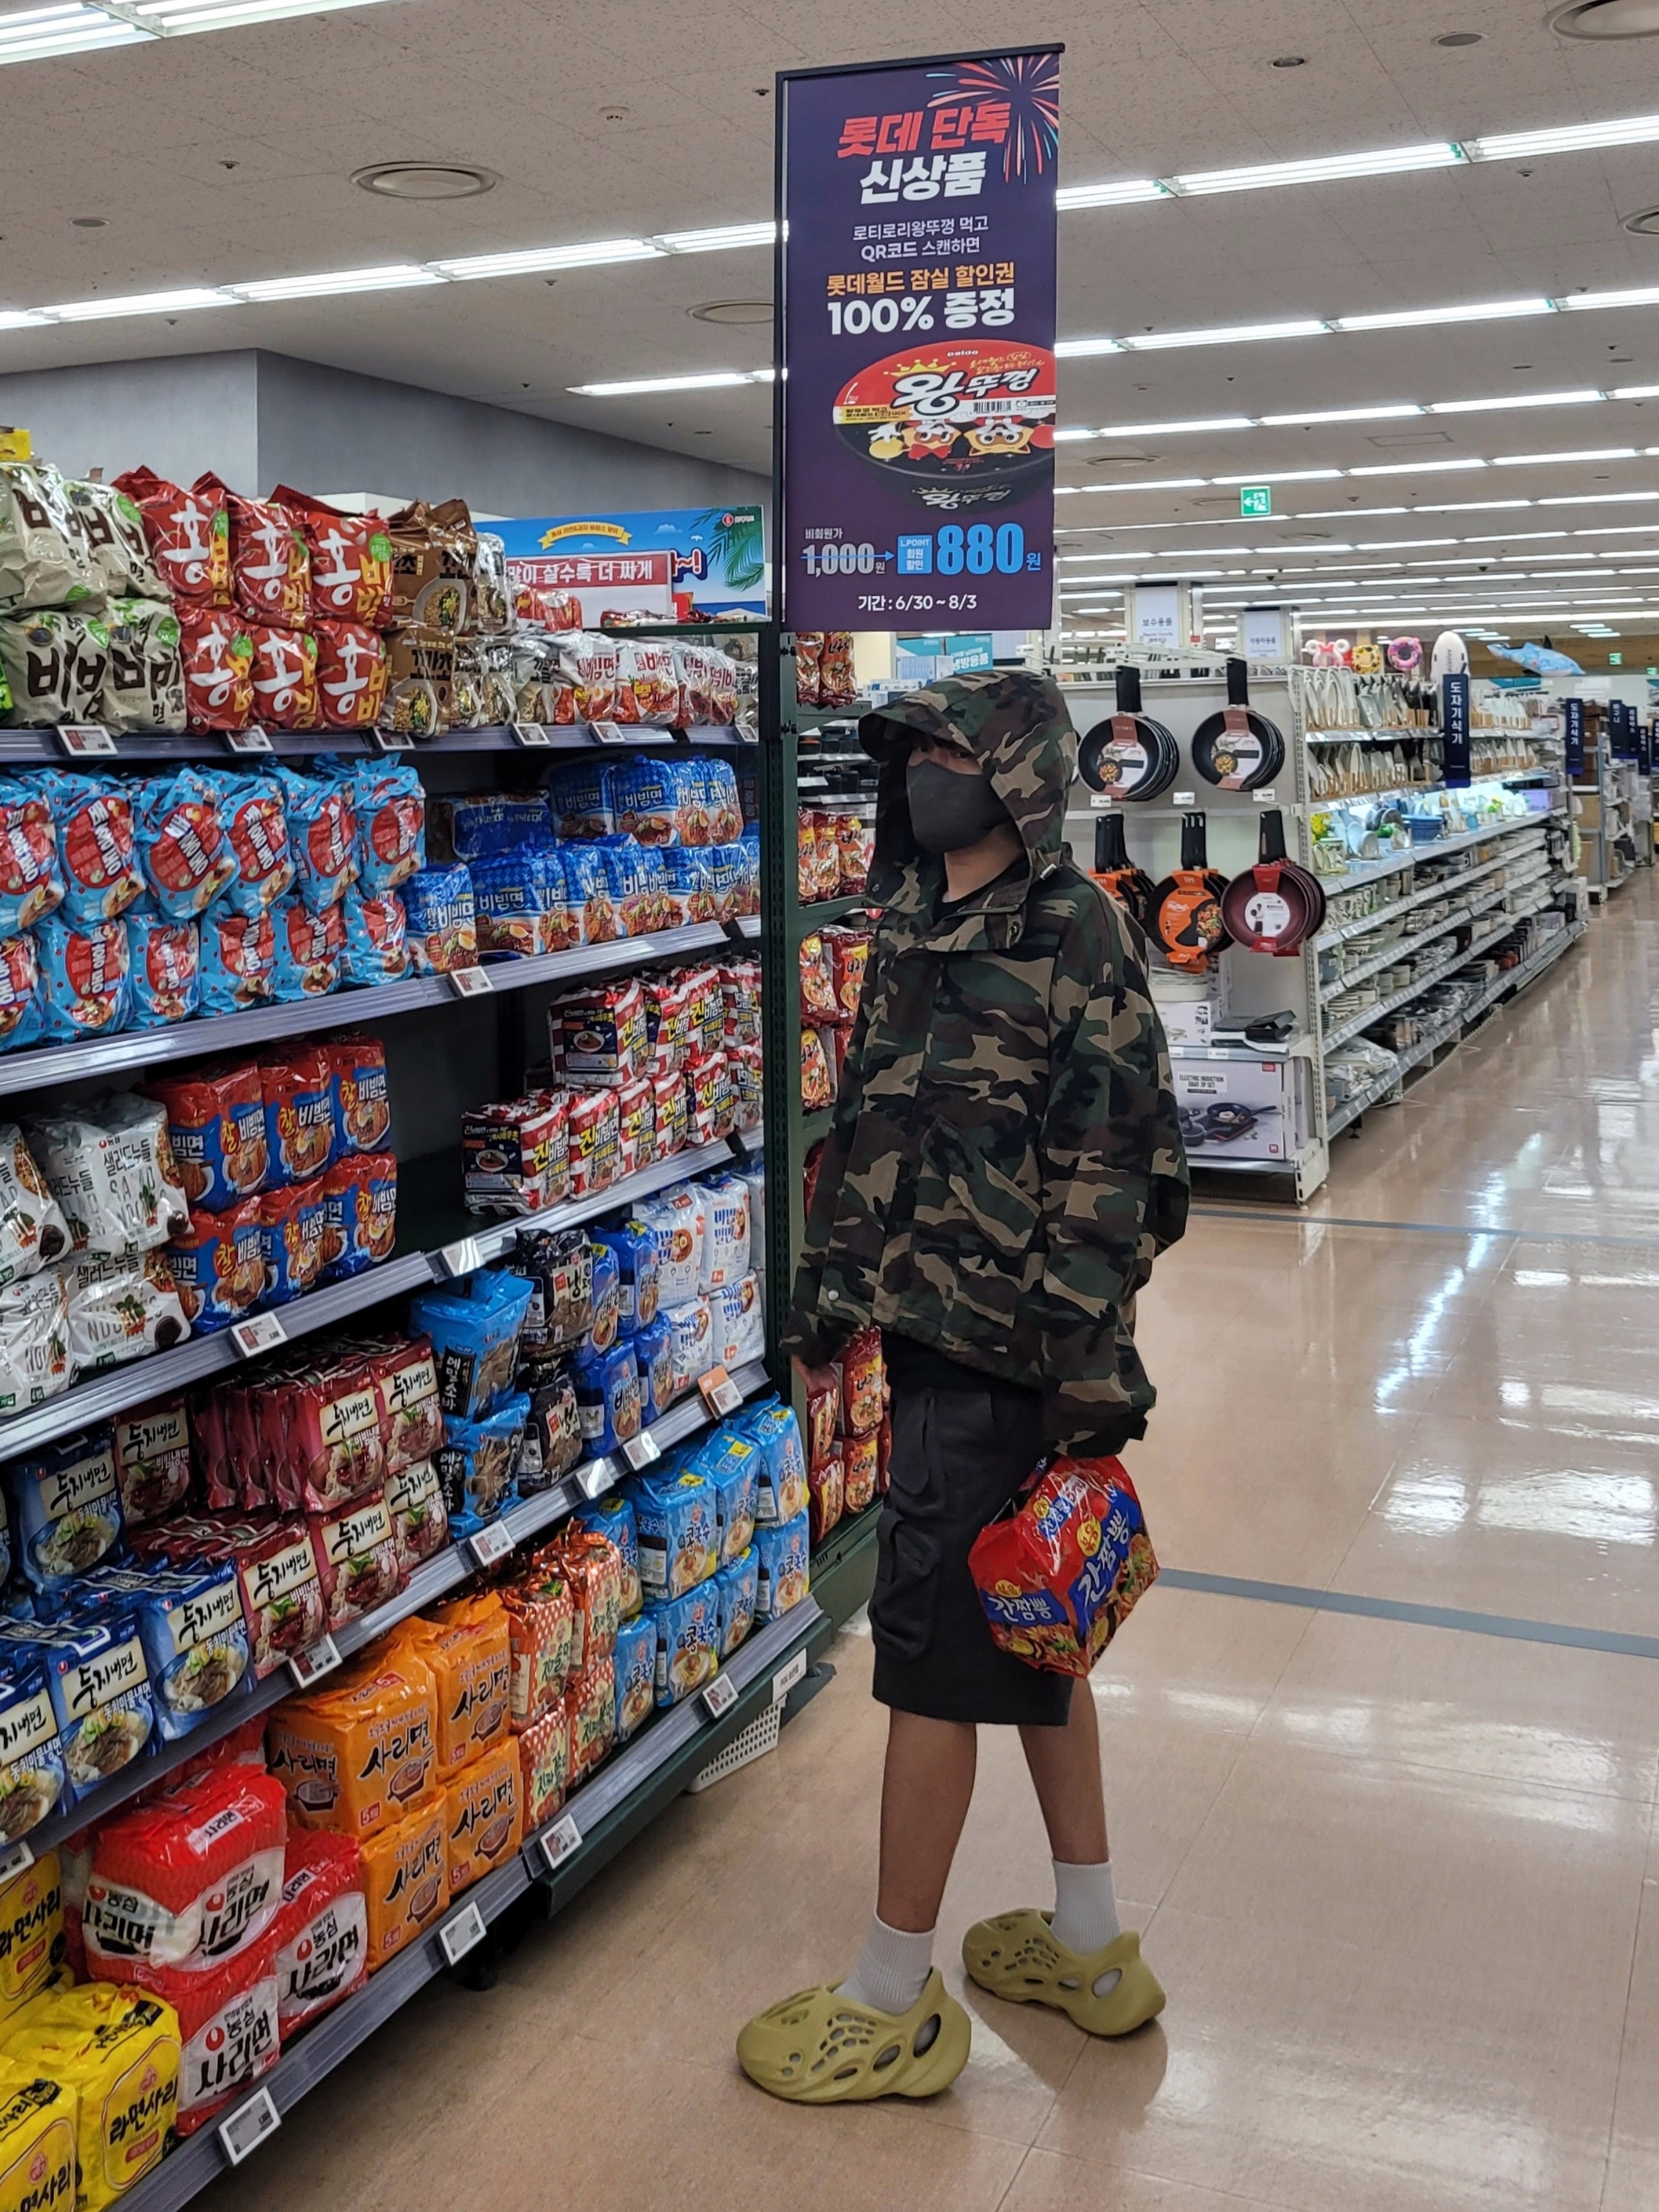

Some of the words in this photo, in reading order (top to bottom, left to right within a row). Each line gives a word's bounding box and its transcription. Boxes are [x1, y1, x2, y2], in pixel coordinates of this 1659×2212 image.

[837, 111, 923, 158] 롯데
[931, 102, 1011, 150] 단독
[860, 151, 986, 204] 신상품
[853, 218, 954, 240] 로티로리왕뚜껑
[959, 216, 988, 232] 먹고
[862, 242, 917, 261] QR코드
[922, 237, 980, 256] 스캔하면
[827, 272, 905, 296] 롯데월드
[911, 268, 948, 290] 잠실
[956, 262, 1015, 286] 할인권
[827, 296, 934, 335] 100%
[945, 288, 1015, 329] 증정
[805, 528, 843, 540] 비회원가
[906, 548, 923, 559] 회원
[543, 559, 591, 584] 살수록
[598, 560, 615, 581] 더
[620, 559, 652, 580] 싸게
[906, 559, 923, 570] 할인
[1450, 682, 1463, 745] 도자기식기
[1570, 703, 1579, 745] 도자기식기
[625, 789, 663, 808] 비빔면
[479, 891, 524, 910] 비빔면
[359, 1073, 386, 1100] 비빔면
[390, 1368, 432, 1408] 둥지냉면
[123, 1419, 181, 1461] 둥지냉면
[50, 1462, 112, 1511] 둥지냉면
[331, 1510, 385, 1556] 둥지냉면
[686, 1522, 711, 1554] 콩국수
[253, 1549, 311, 1600] 둥지냉면
[1078, 1509, 1129, 1607] 간짬뽕
[178, 1589, 235, 1644] 둥지냉면
[988, 1596, 1052, 1622] 간짬뽕
[686, 1618, 716, 1651] 콩국수
[73, 1651, 138, 1709] 둥지냉면
[104, 1680, 152, 1722] 동치미물냉면
[451, 1664, 508, 1721] 사리면
[0, 1705, 47, 1750] 지냉면
[359, 1714, 430, 1778] 사리면
[10, 1736, 63, 1782] 동치미물냉면
[273, 1747, 337, 1782] 사리면
[451, 1773, 513, 1840] 사리면
[386, 1830, 441, 1903] 사리면
[107, 1891, 138, 1913] 농심
[189, 1879, 270, 1955] 사리면
[283, 1924, 359, 2001] 사리면
[195, 2012, 272, 2097] 사리면
[109, 2075, 178, 2145] 라면사리
[6, 2162, 72, 2212] 면사리
